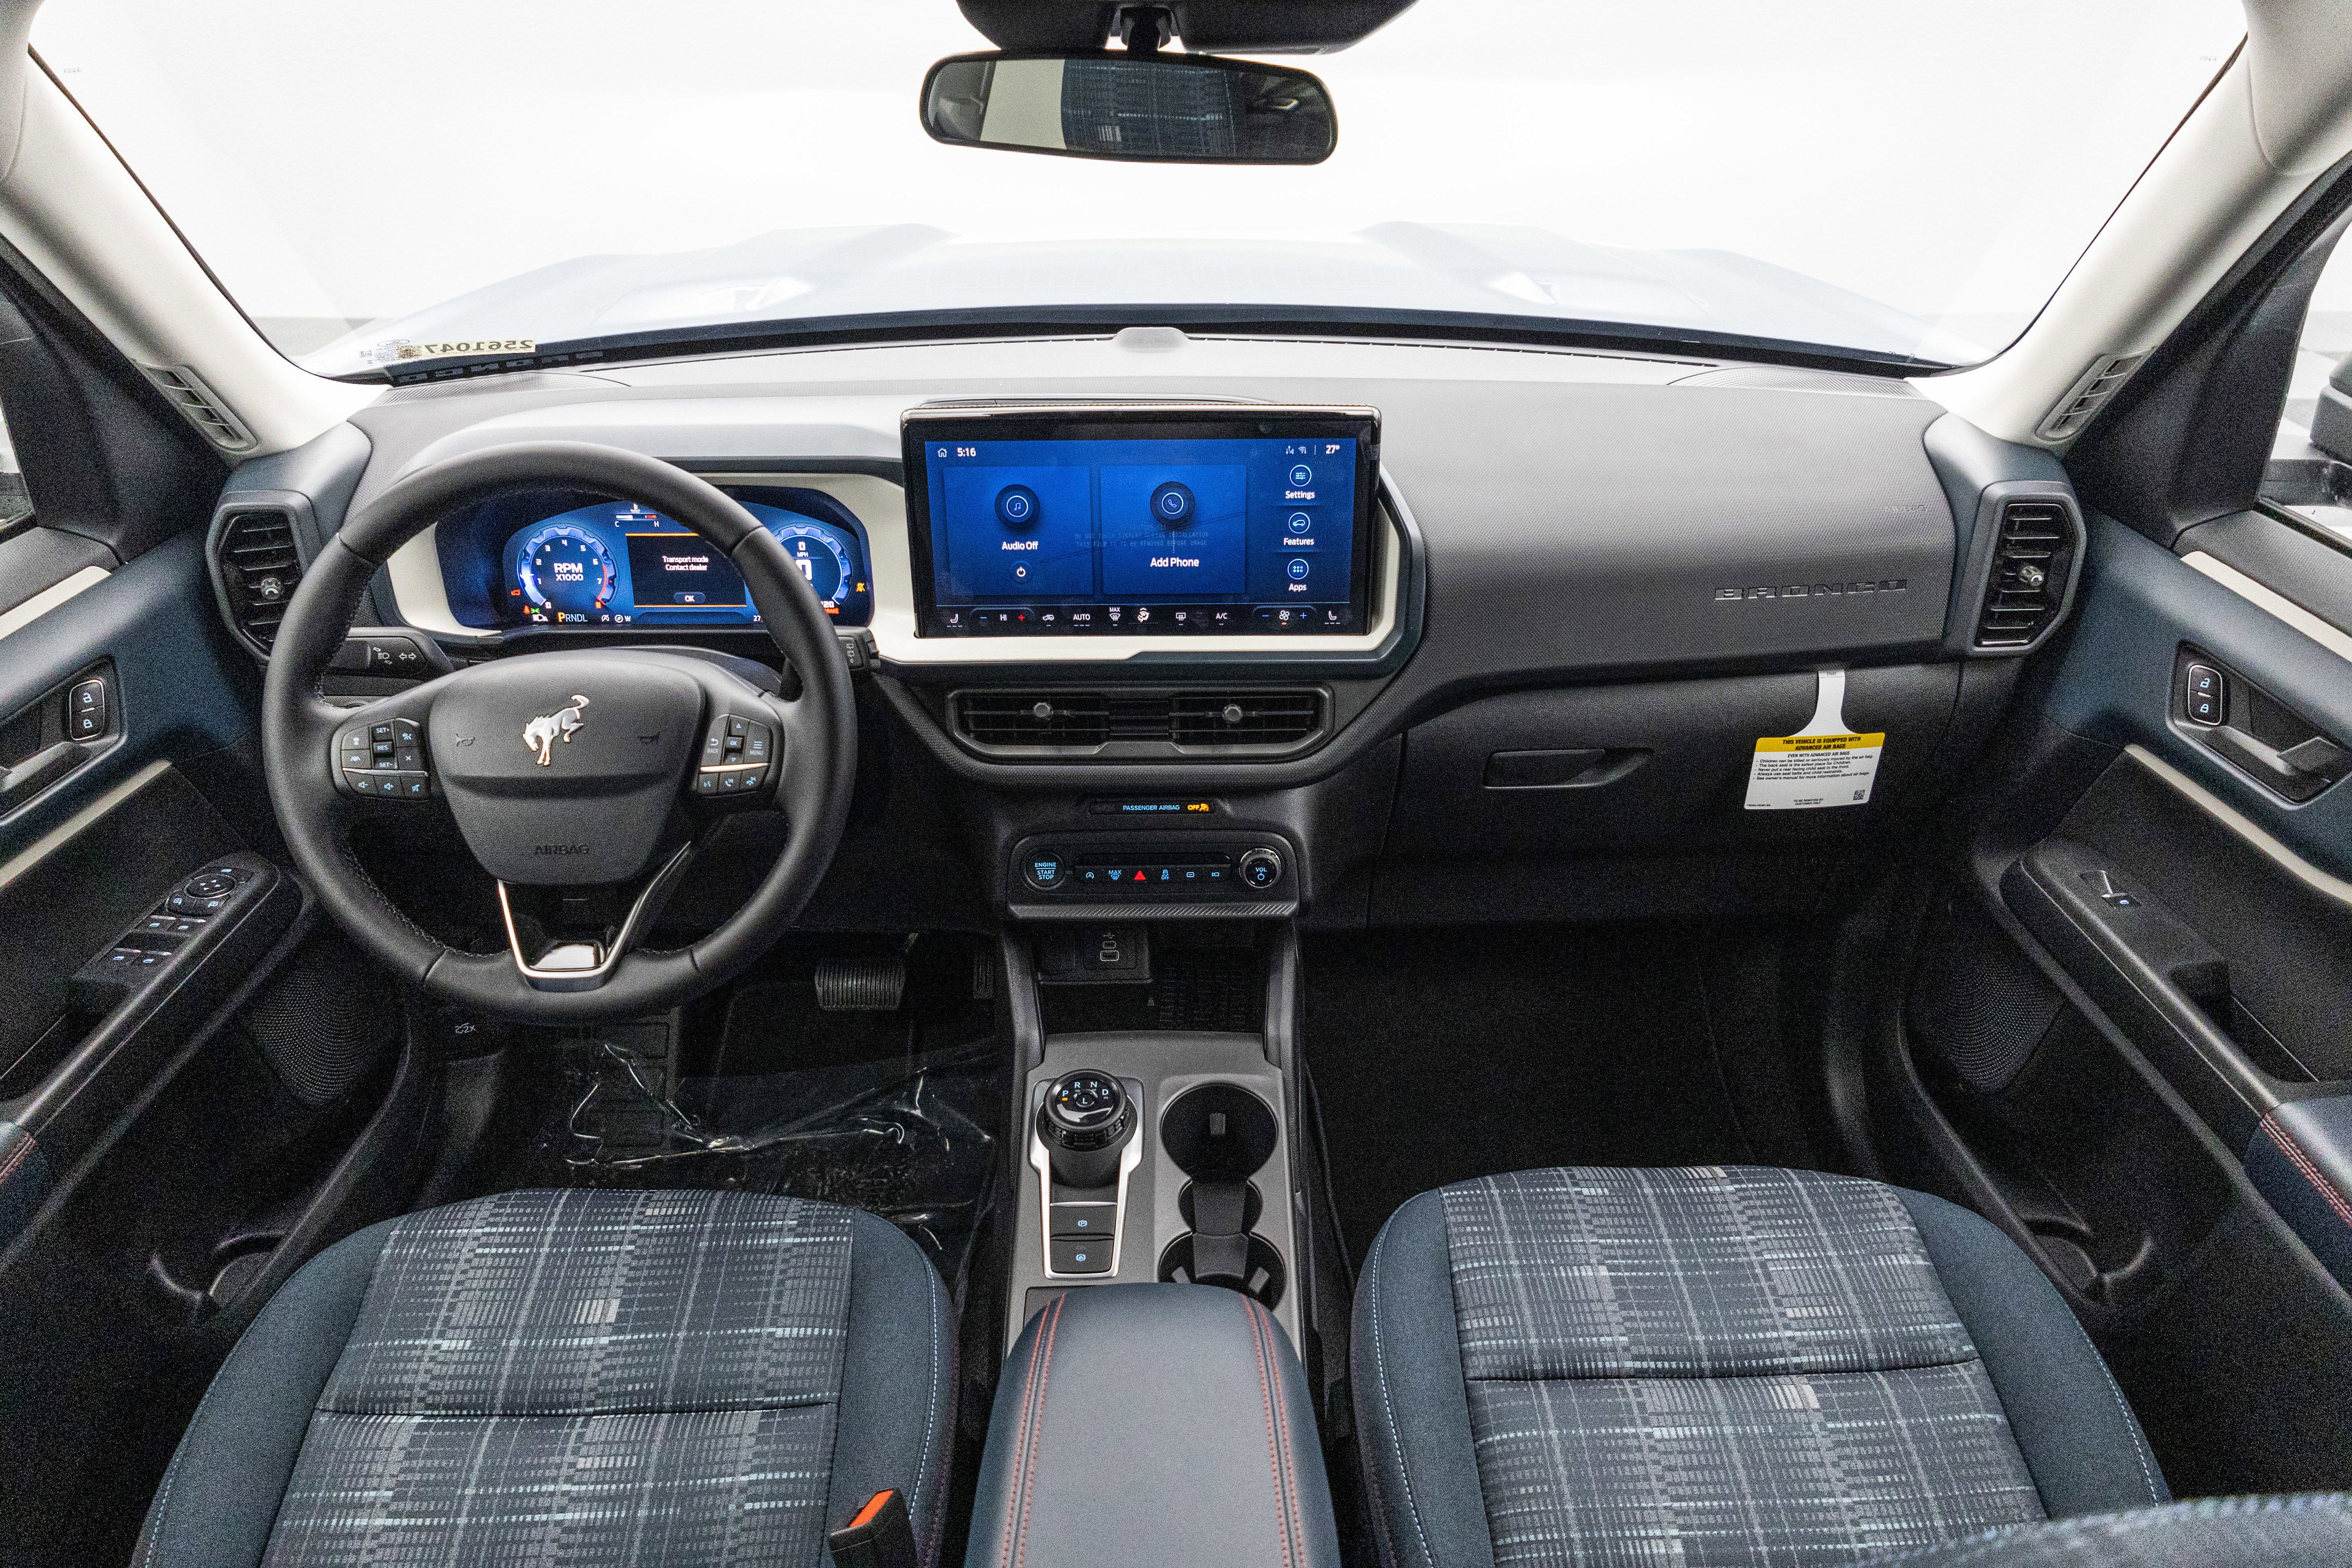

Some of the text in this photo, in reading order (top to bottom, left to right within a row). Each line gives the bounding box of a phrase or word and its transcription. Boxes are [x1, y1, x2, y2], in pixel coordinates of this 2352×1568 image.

[957, 448, 976, 457] 5:16
[1326, 444, 1340, 454] 27°
[1285, 491, 1315, 499] Settings
[798, 541, 806, 551] 0
[1002, 541, 1038, 550] Audio Off
[1150, 557, 1199, 567] Add Phone
[554, 563, 583, 572] RPM
[1289, 584, 1307, 592] Apps
[1715, 580, 1907, 600] BRONCO
[533, 844, 590, 855] AIRBAG
